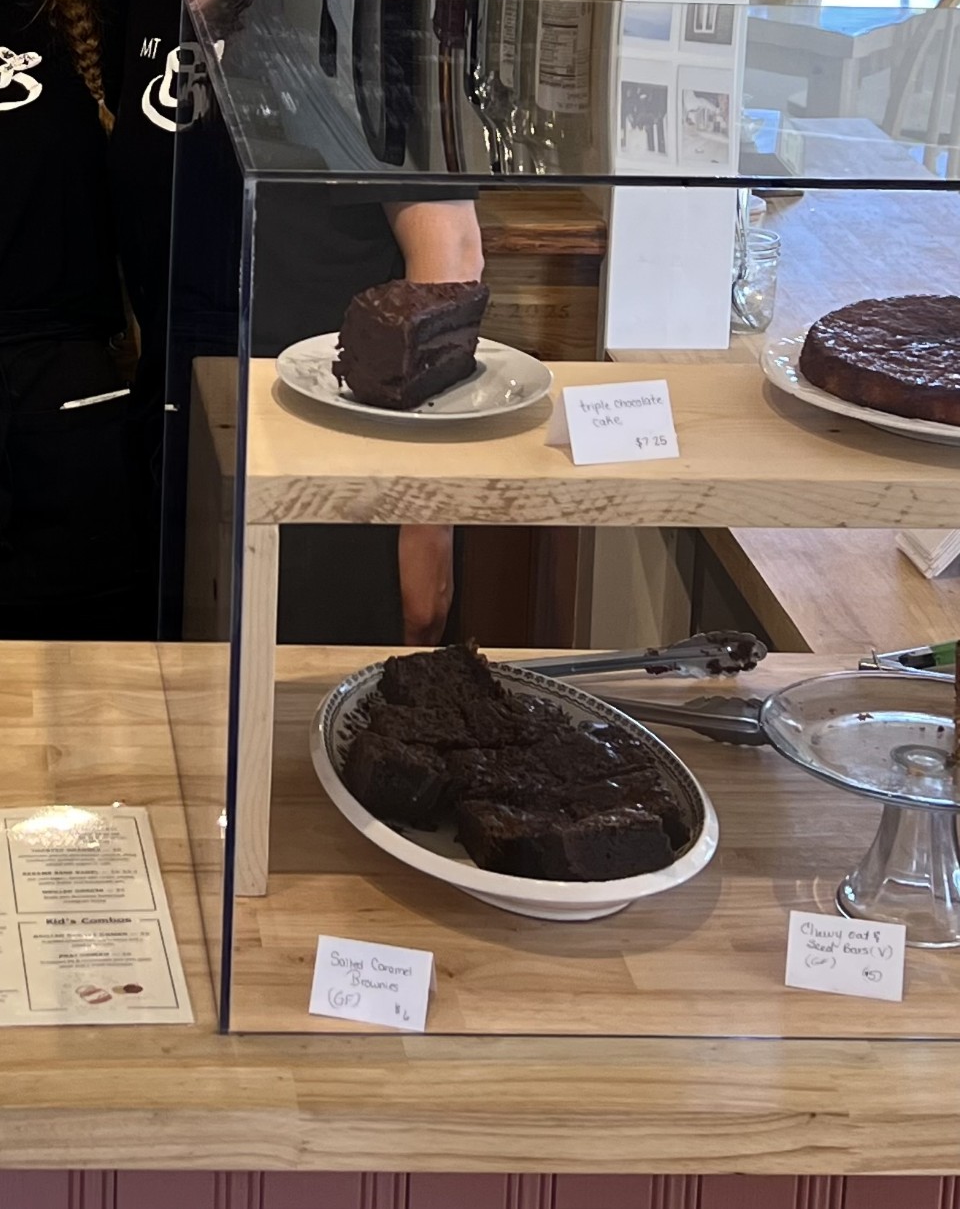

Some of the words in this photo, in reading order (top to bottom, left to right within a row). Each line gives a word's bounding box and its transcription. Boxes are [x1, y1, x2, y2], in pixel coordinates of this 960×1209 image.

[140, 37, 161, 60] MT
[580, 399, 612, 415] triple
[592, 416, 623, 427] cake
[46, 917, 76, 925] Kid's
[331, 951, 364, 970] Salted
[371, 957, 412, 976] Caramel
[346, 968, 398, 992] Brownies
[328, 987, 361, 1009] (GF)
